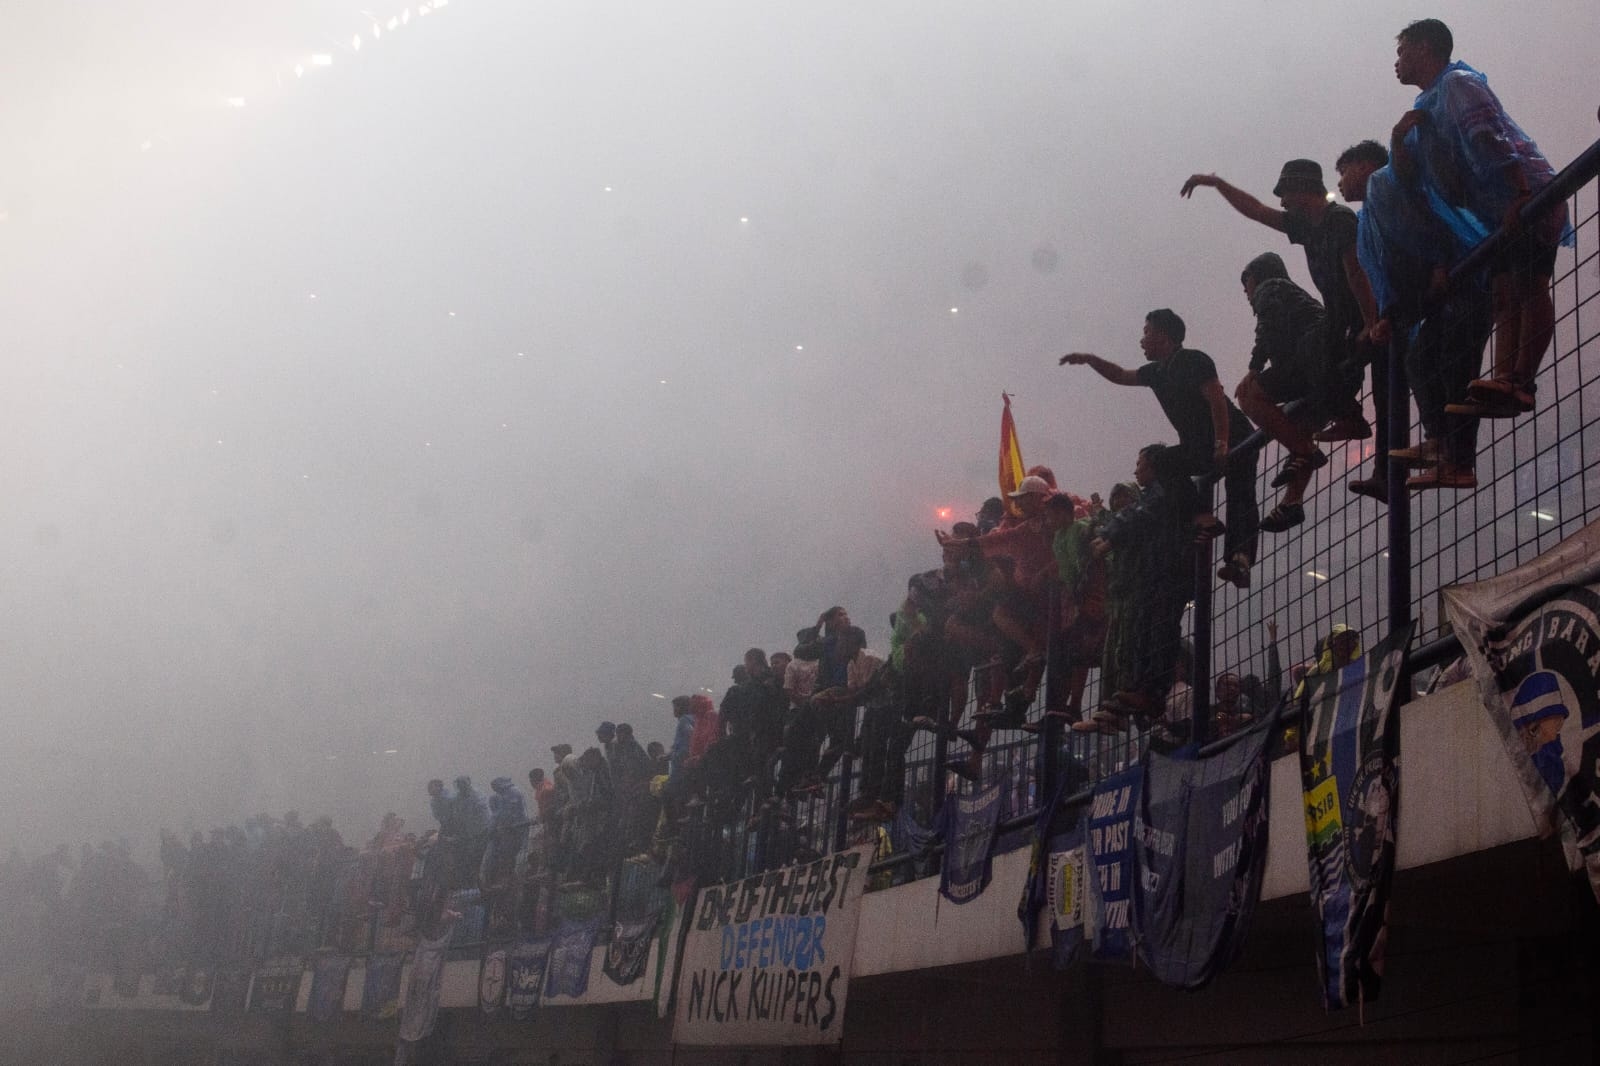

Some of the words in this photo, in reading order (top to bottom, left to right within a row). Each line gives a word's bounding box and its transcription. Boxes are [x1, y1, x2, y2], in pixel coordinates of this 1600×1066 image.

[1547, 615, 1600, 679] BARA
[1104, 820, 1130, 854] PAST
[697, 884, 738, 931] ONE
[735, 873, 763, 924] OF
[761, 864, 807, 915] THE
[799, 852, 862, 916] BEST
[688, 968, 743, 1023] NICK
[747, 965, 841, 1031] KUIPERS
